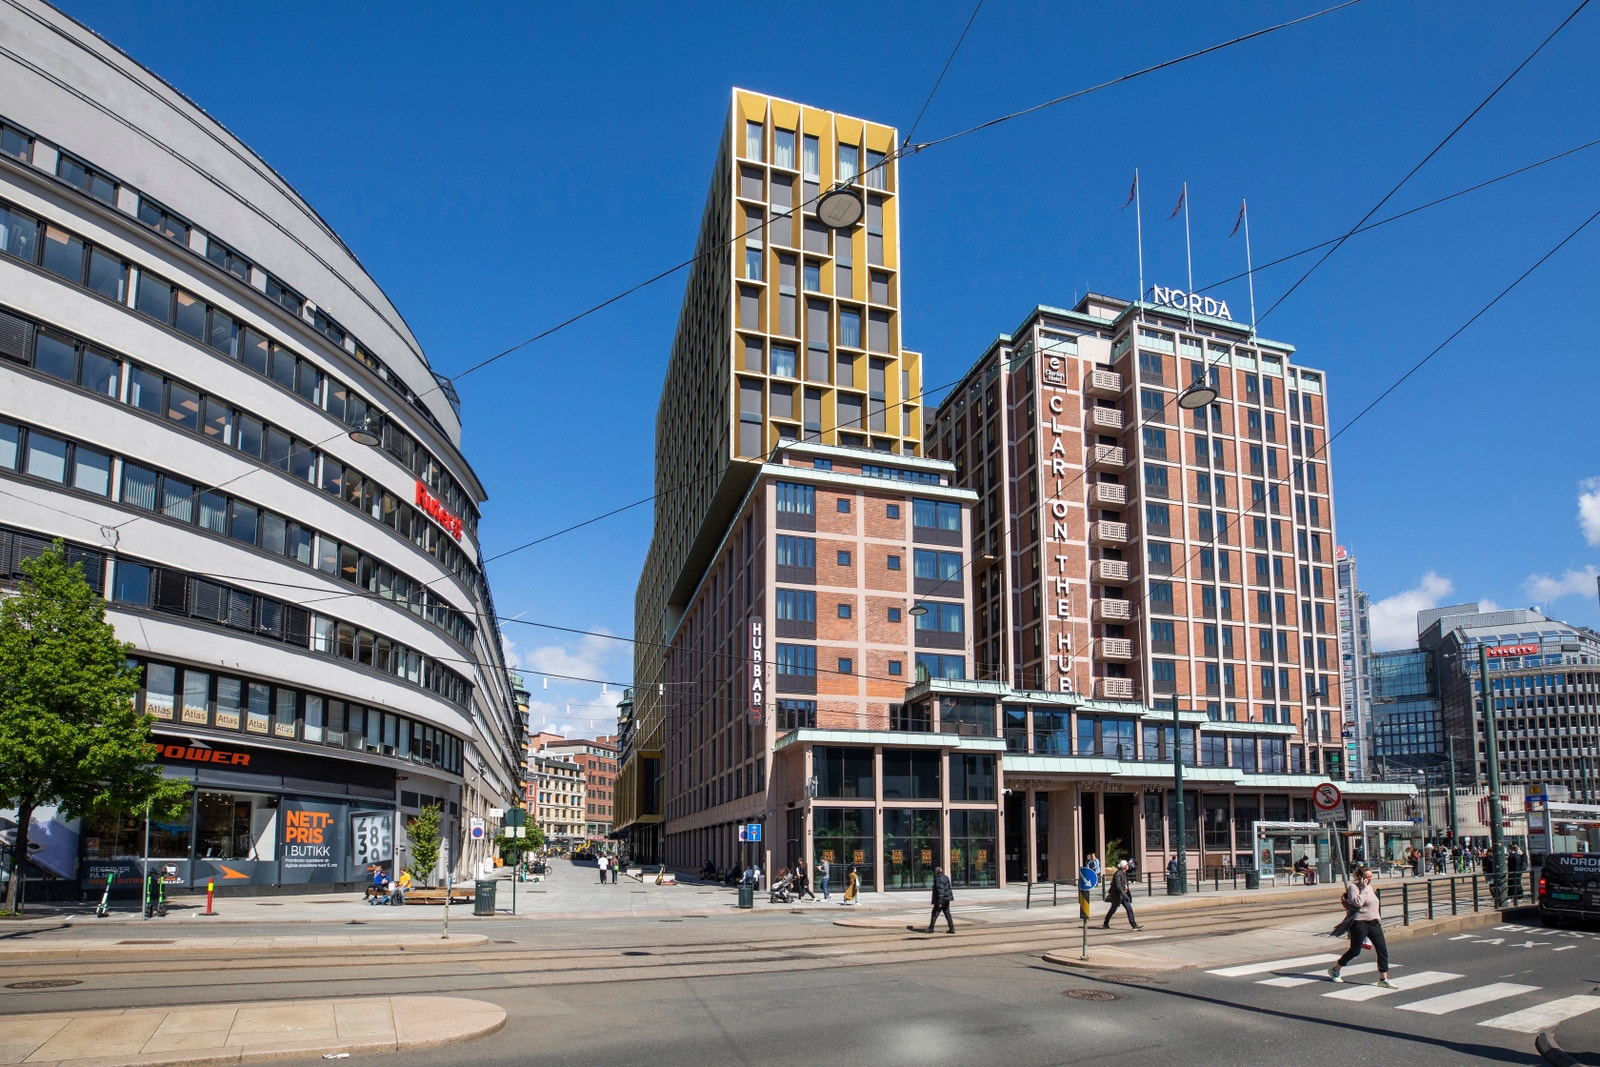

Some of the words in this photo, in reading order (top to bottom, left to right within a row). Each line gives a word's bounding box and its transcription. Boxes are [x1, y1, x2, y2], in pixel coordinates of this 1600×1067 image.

[1153, 283, 1233, 321] NORDA
[1050, 395, 1068, 539] CLARION
[1055, 554, 1070, 617] THE
[1058, 632, 1073, 692] HUB
[148, 704, 171, 715] Atlas
[184, 709, 206, 720] Atlas
[217, 714, 238, 725] Atlas
[248, 719, 267, 730] Atlas
[276, 724, 294, 734] Atlas
[286, 810, 334, 829] NETT-
[285, 826, 324, 844] PRIS
[285, 846, 288, 856] I
[291, 846, 330, 857] BUTIKK
[1448, 934, 1579, 951] TAXI
